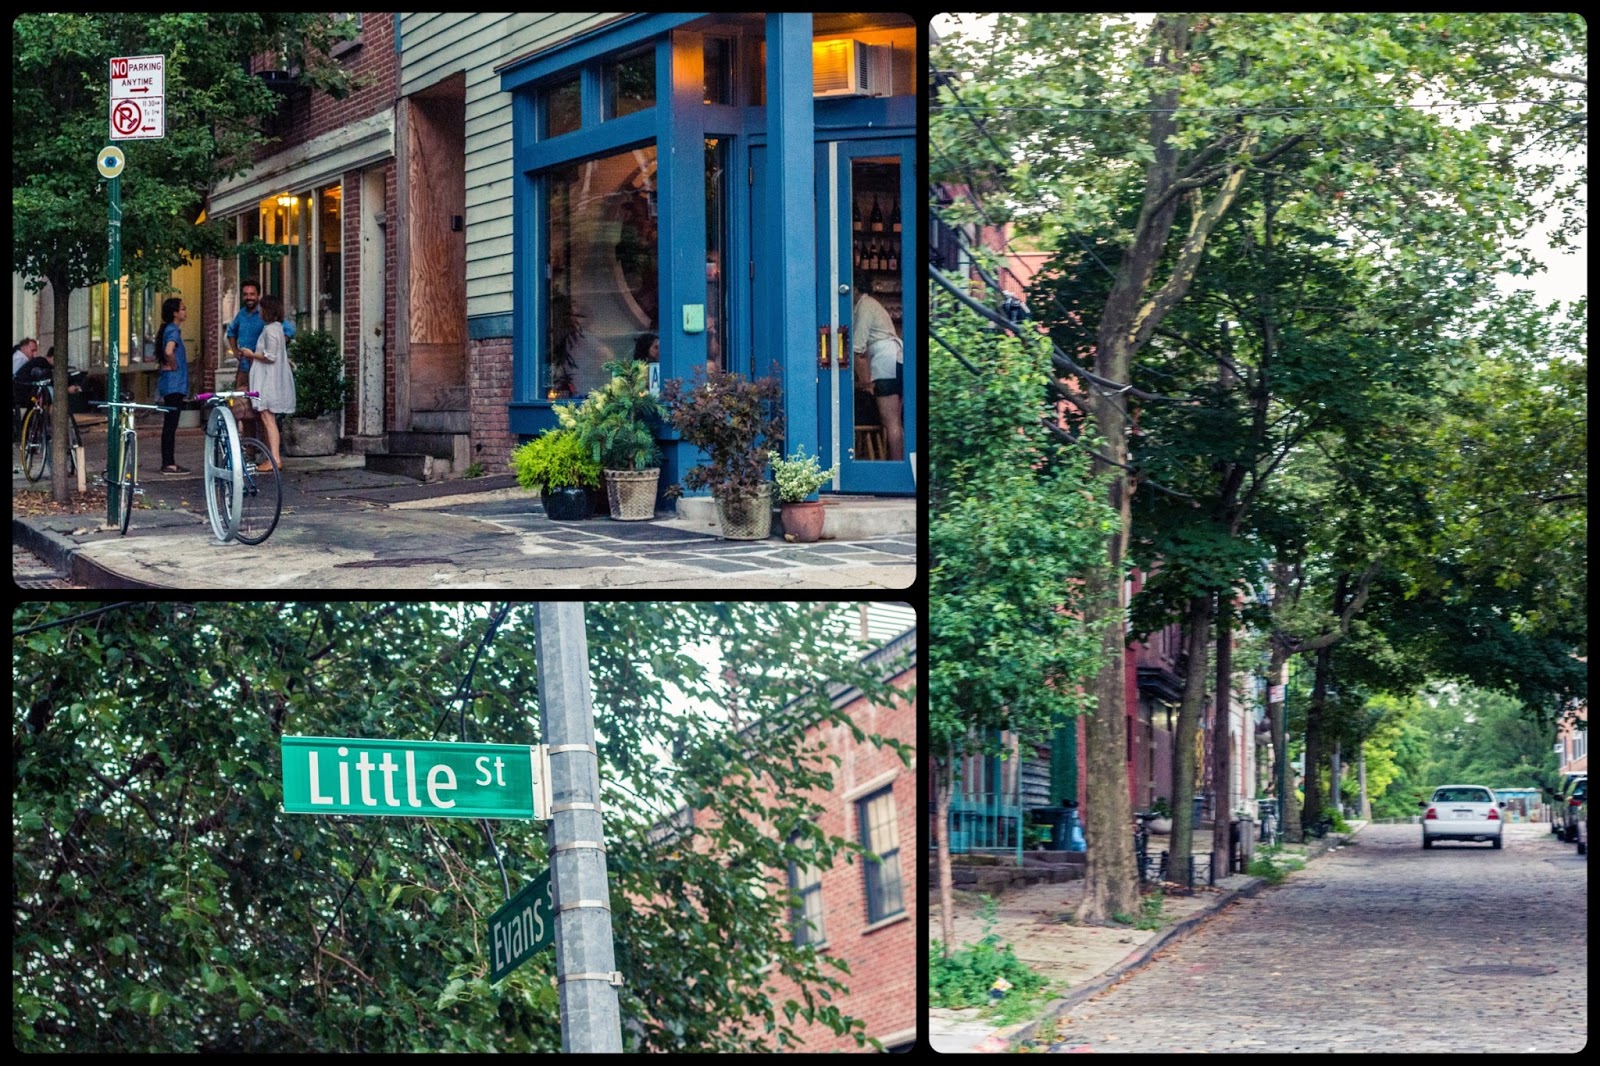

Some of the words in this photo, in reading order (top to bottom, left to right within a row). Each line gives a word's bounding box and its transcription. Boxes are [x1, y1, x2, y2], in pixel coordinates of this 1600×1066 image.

[112, 62, 127, 76] NO
[129, 62, 161, 71] PARKING
[122, 78, 153, 86] ANYTIME
[651, 367, 660, 388] A
[308, 747, 457, 809] Little
[475, 755, 506, 787] St
[493, 896, 544, 973] Evans
[546, 880, 554, 910] S
